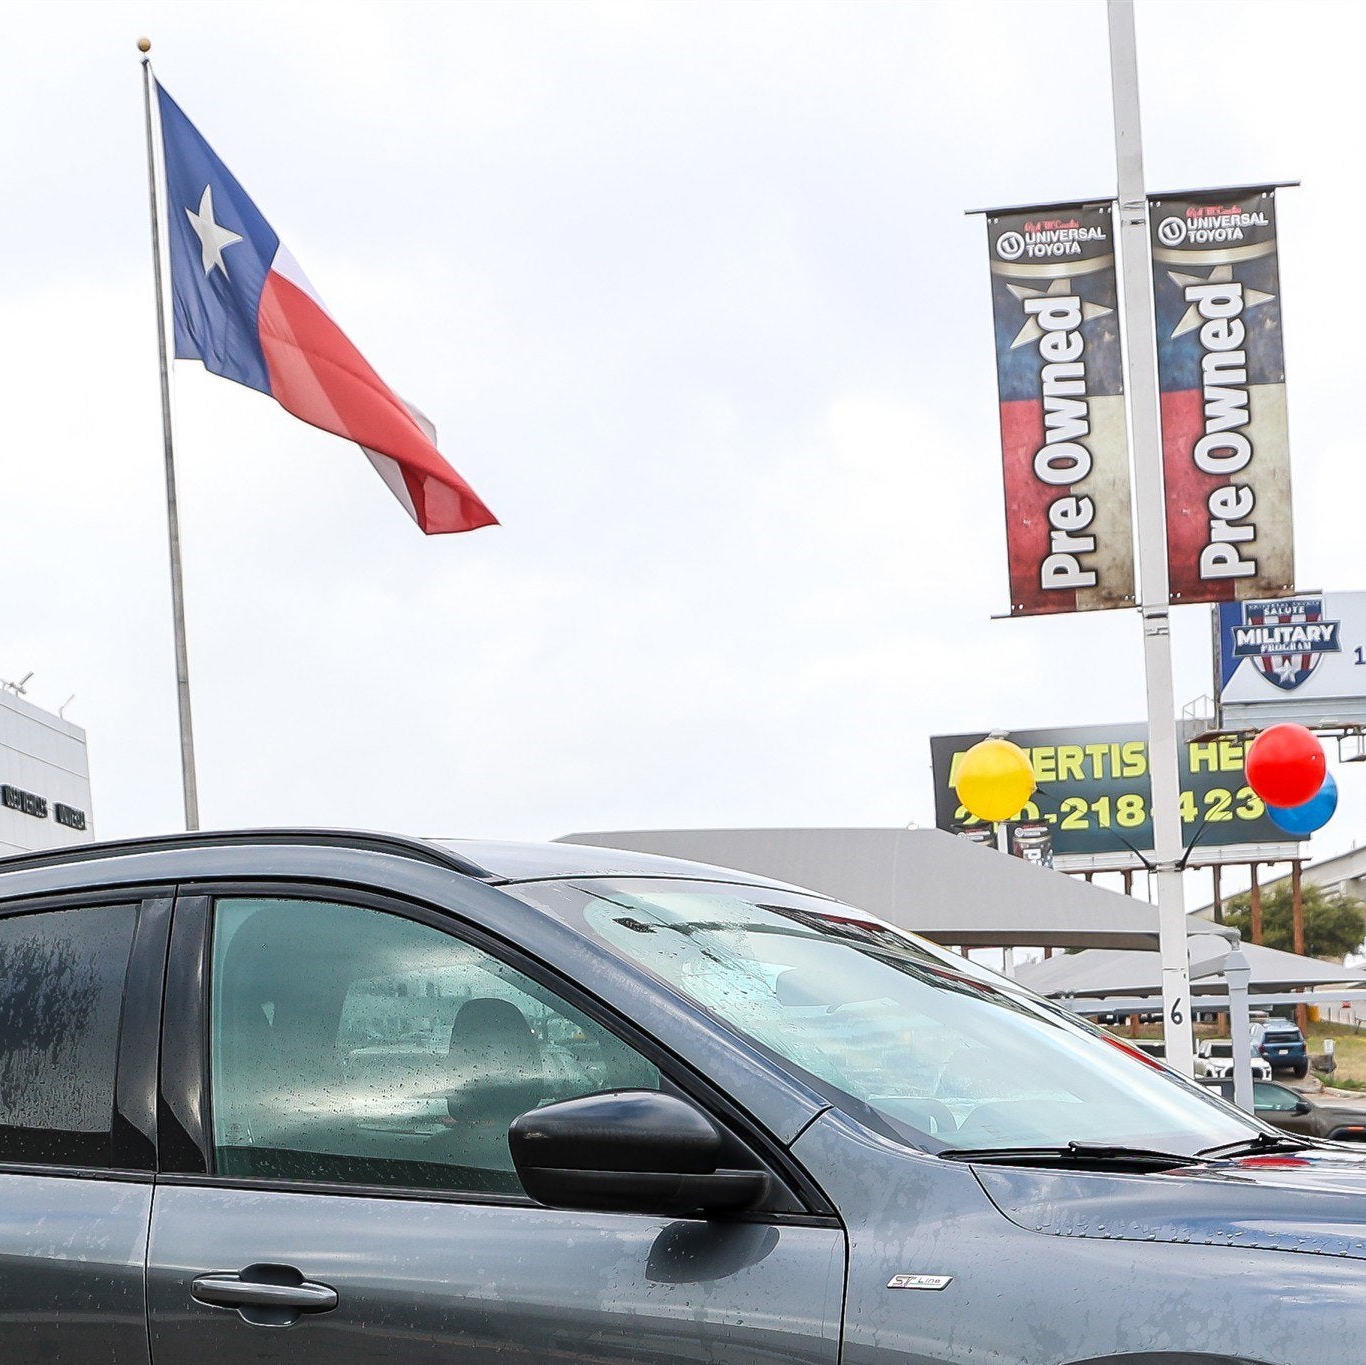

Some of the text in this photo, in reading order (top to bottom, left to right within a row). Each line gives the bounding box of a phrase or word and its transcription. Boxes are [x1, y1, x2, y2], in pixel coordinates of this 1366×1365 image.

[1187, 212, 1269, 229] UNIVERSAL
[1025, 226, 1106, 243] UNIVERSAL
[1187, 227, 1243, 243] TOYOTA
[1026, 241, 1082, 258] TOYOTA
[1185, 283, 1253, 474] Owned
[1024, 296, 1092, 485] Owned
[1042, 496, 1097, 590] Pre
[1201, 485, 1256, 580] Pre
[1264, 605, 1305, 616] SALUTE
[1236, 625, 1334, 646] MILITARY
[1171, 997, 1183, 1025] 6
